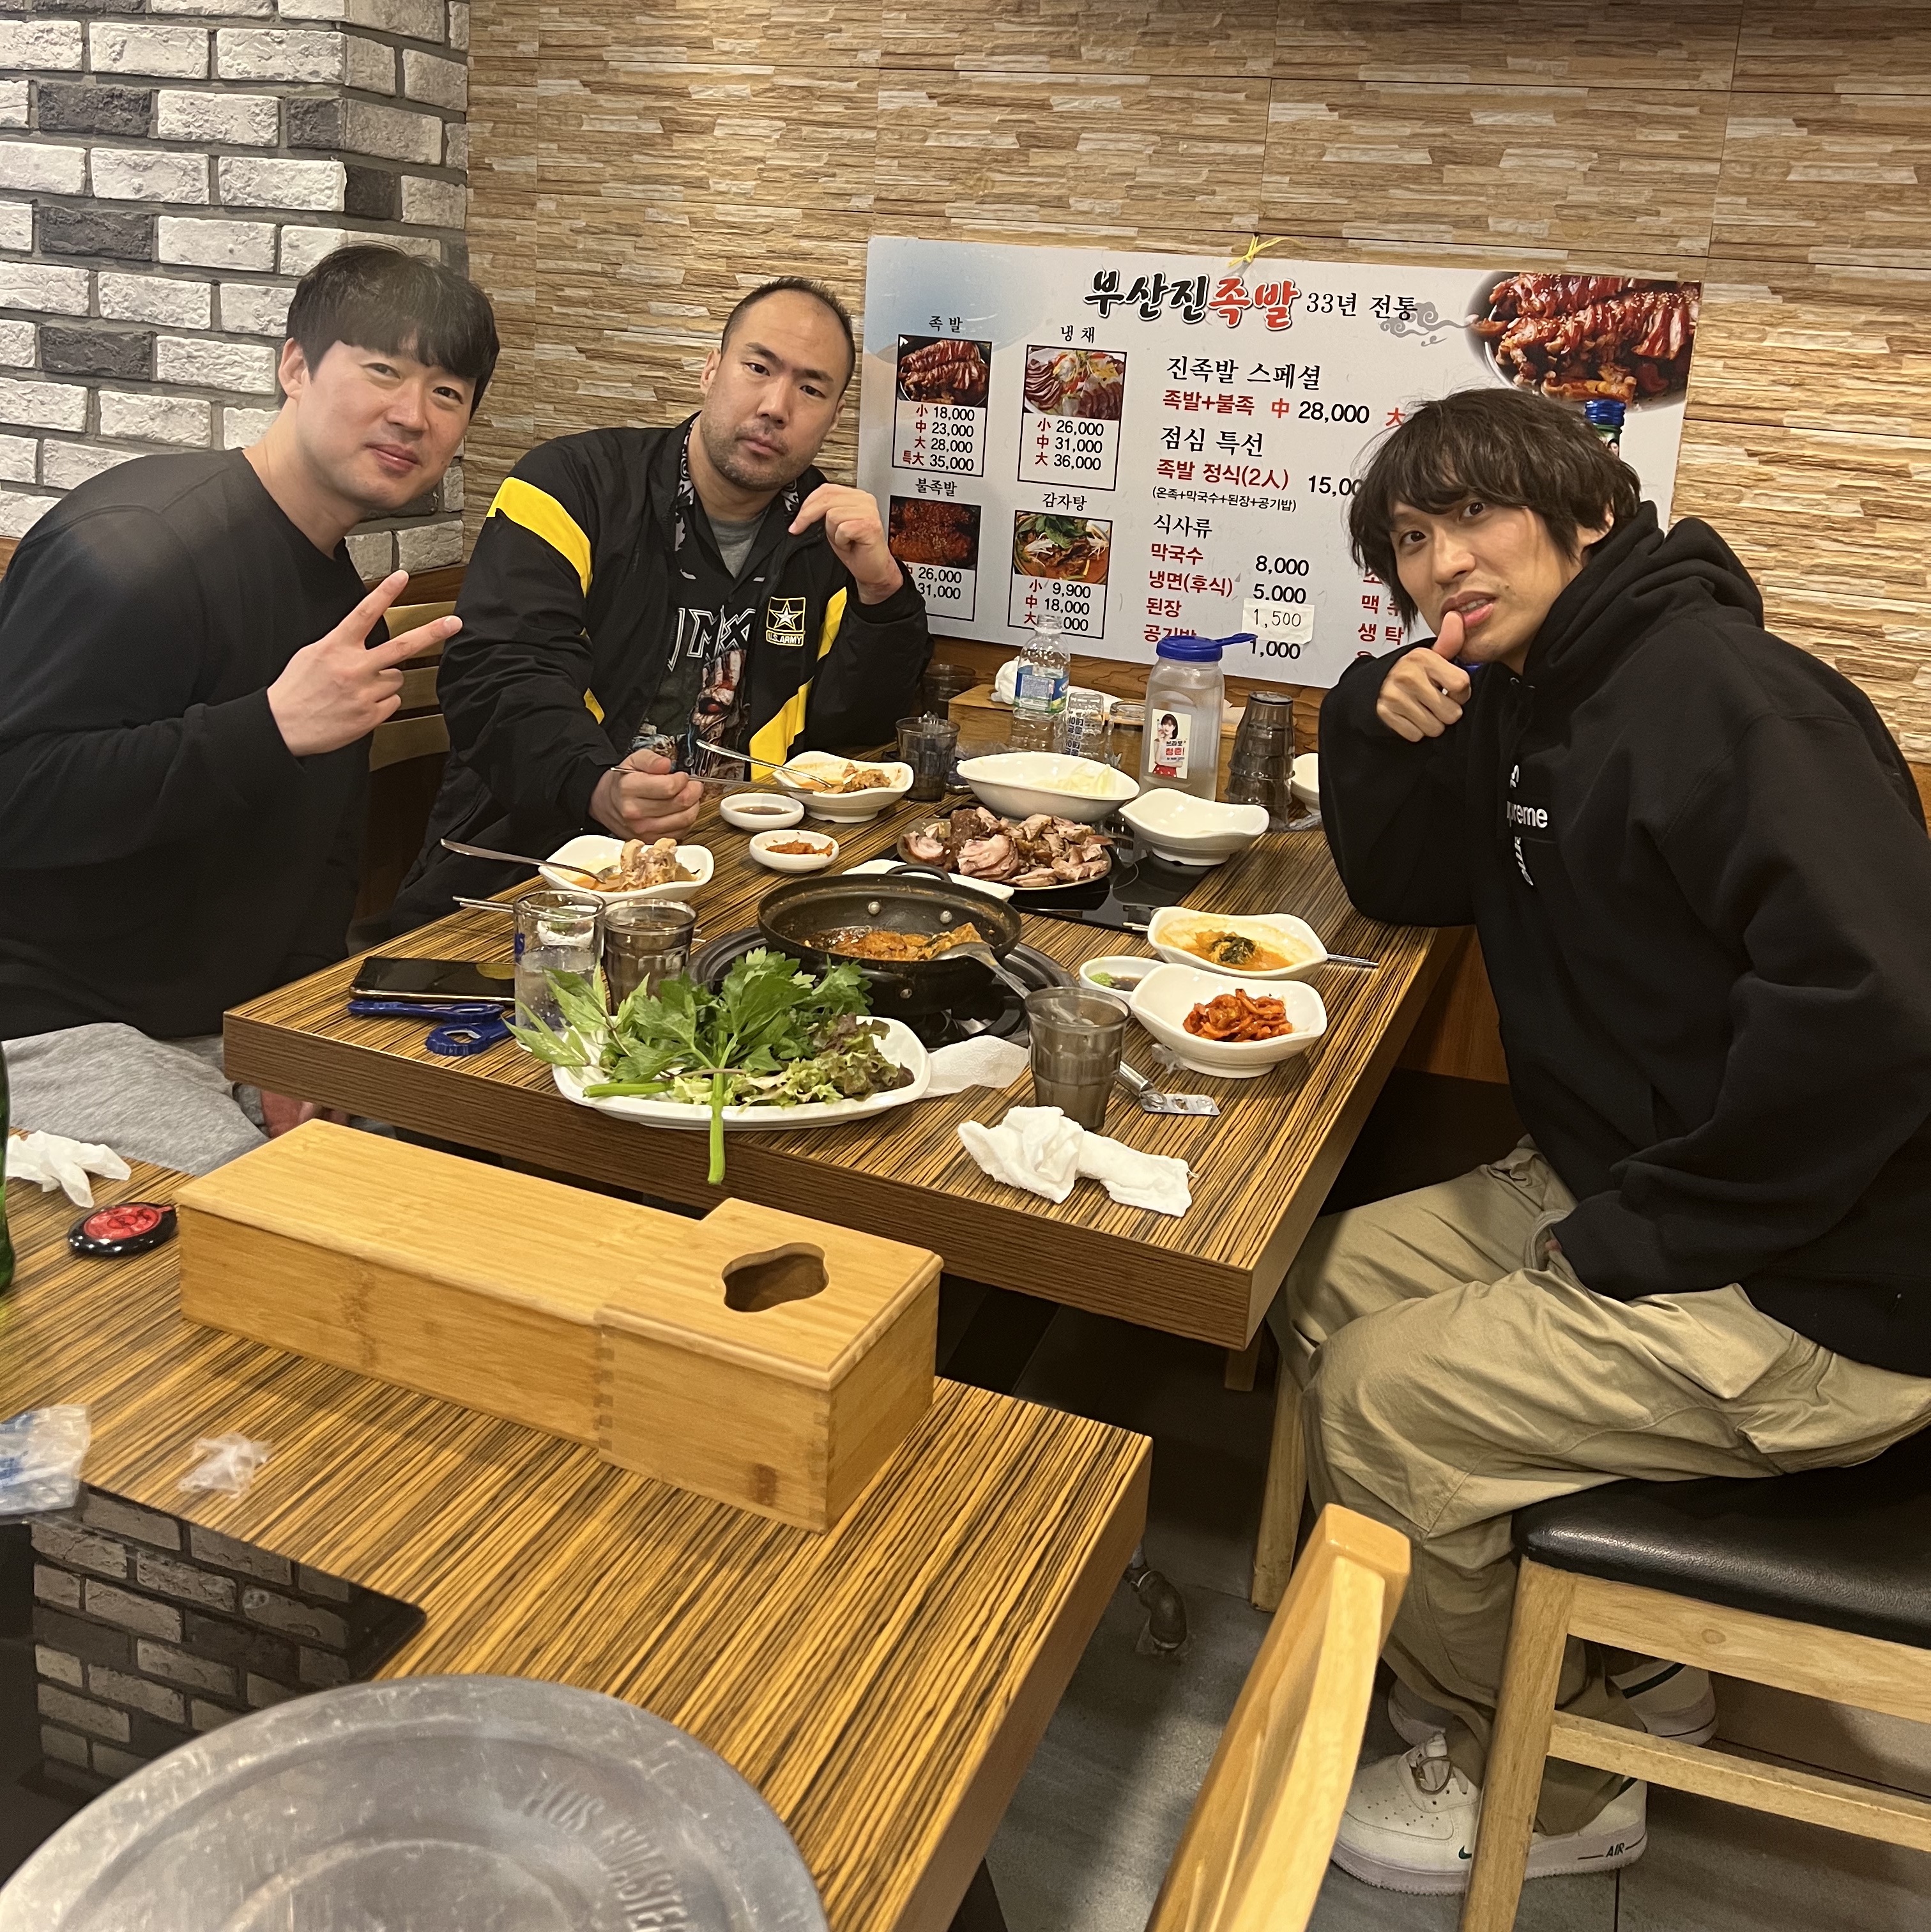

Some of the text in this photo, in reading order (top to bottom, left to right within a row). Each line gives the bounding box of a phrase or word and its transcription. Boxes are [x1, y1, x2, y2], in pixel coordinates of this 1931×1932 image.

[1083, 270, 1418, 331] 부산진족발 33년 전통
[1166, 355, 1321, 391] 진족발 스페셜
[915, 404, 975, 422] 小 18,000
[1163, 389, 1255, 416] 족발+불족
[1271, 398, 1290, 419] 中
[1298, 401, 1370, 424] 28,000
[915, 419, 975, 438] 中 23,000
[1037, 417, 1104, 436] 小 26,000
[914, 435, 973, 454] 大 28,000
[1036, 434, 1103, 454] 中 31,000
[1160, 425, 1263, 457] 점심 특선
[929, 454, 975, 471] 35,000
[1034, 451, 1102, 471] 大 36,000
[1156, 459, 1196, 480] 족발
[1202, 463, 1289, 491] 정식(2人)
[915, 477, 958, 497] 불족발
[1042, 491, 1088, 512] 감자탕
[1152, 513, 1213, 539] 식사류
[1150, 543, 1310, 576] 막국수 8,000
[918, 566, 963, 584] 26,000
[1149, 570, 1233, 598] 냉면(후식)
[917, 582, 961, 601] 31,000
[1028, 578, 1092, 599] 小 9,900
[1025, 594, 1090, 615] 中 18,000
[1145, 597, 1182, 618] 된장
[1361, 595, 1380, 614] 맥
[1023, 611, 1037, 625] 大
[1253, 608, 1302, 629] 1,500
[779, 635, 802, 645] ARMY
[1249, 640, 1301, 660] 1,000
[1605, 1842, 1625, 1858] AIR
